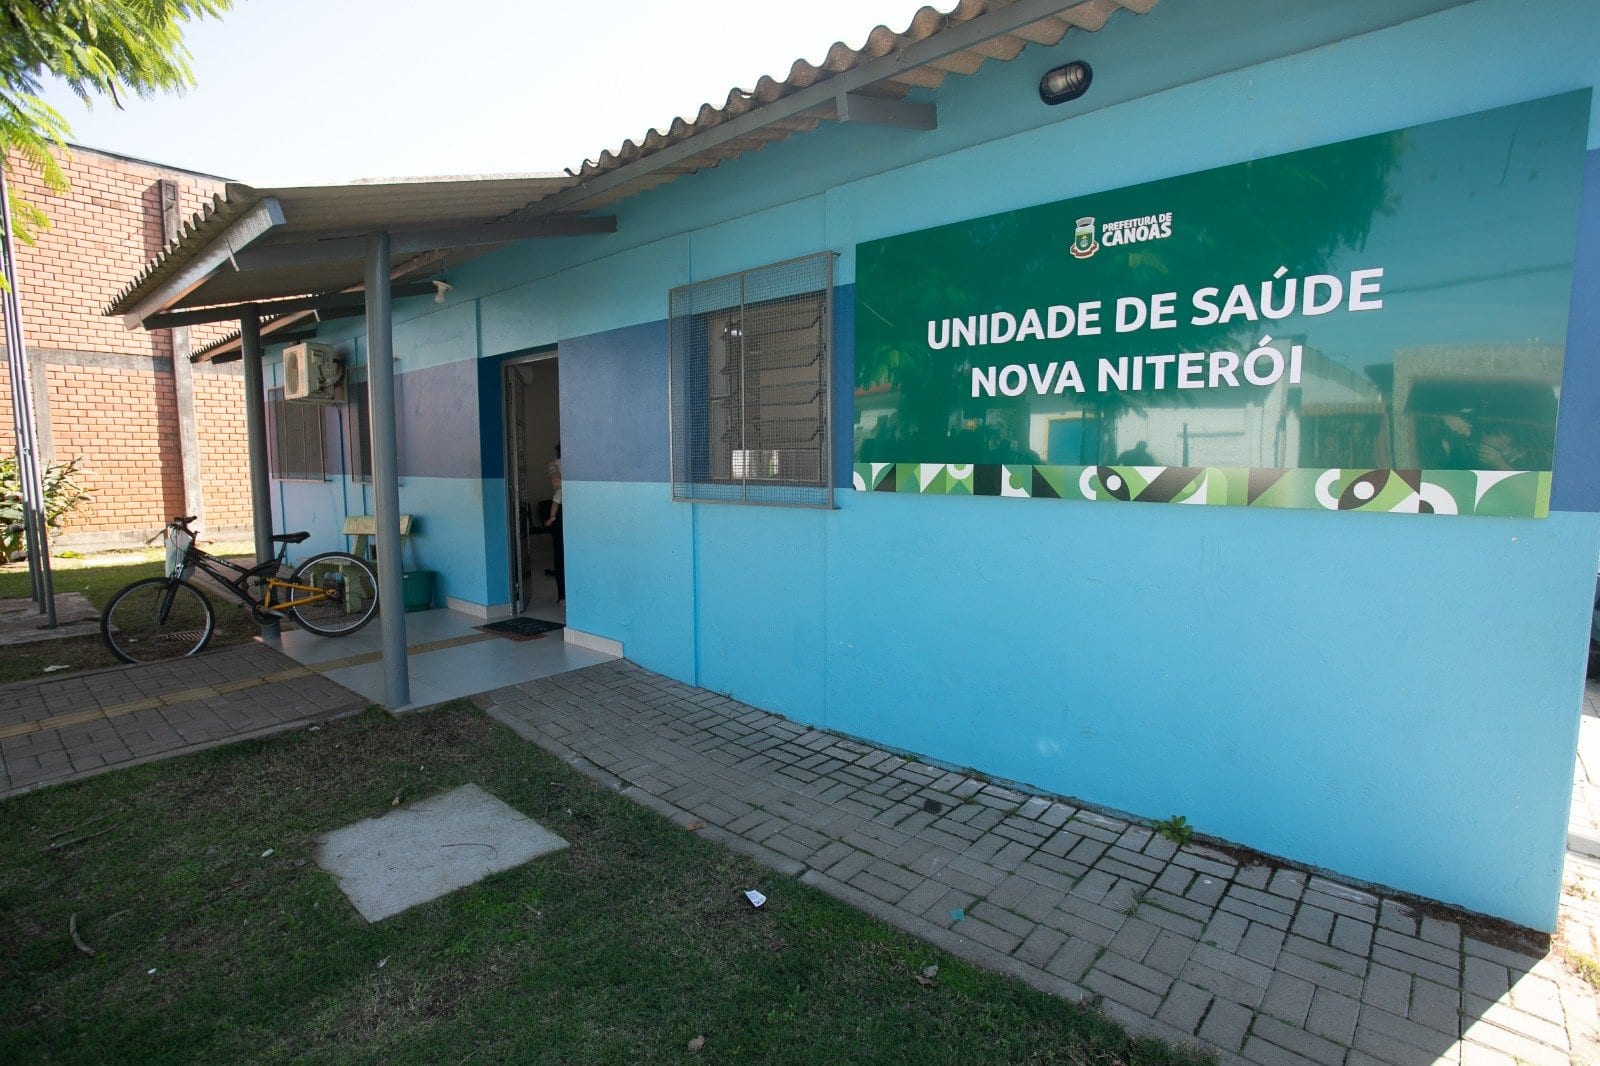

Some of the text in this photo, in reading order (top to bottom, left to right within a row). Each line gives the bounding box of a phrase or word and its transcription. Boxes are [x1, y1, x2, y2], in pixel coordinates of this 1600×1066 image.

[1101, 221, 1172, 247] CANOAS
[1102, 212, 1173, 233] PREFEITURA DE
[927, 265, 1384, 350] UNIDADE DE SAÚDE
[971, 334, 1303, 398] NOVA NITERÓI
